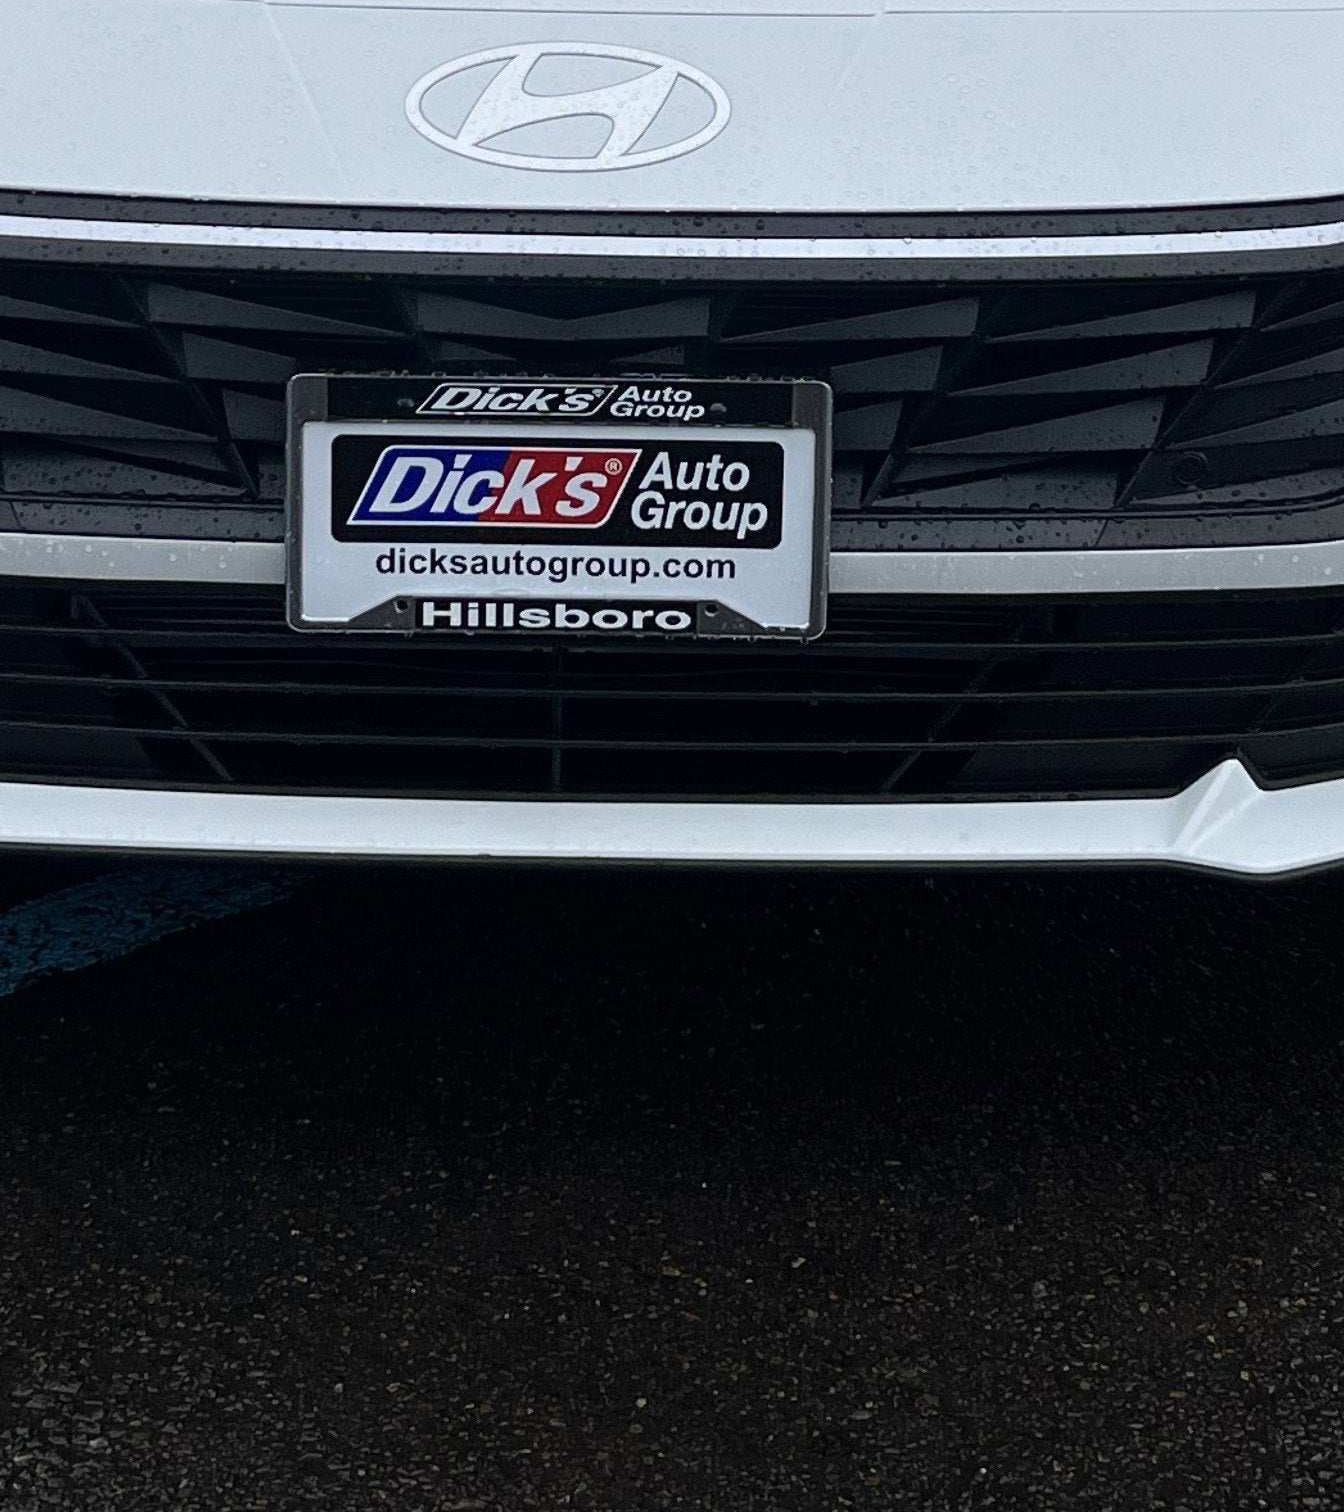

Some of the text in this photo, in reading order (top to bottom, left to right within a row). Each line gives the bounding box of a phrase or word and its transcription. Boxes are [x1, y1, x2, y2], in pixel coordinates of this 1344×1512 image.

[609, 400, 706, 421] Group
[617, 385, 692, 403] Auto
[638, 451, 751, 493] Auto
[630, 491, 769, 540] Group
[375, 548, 737, 584] dicksautogroup.com
[422, 601, 692, 631] Hillsboro
